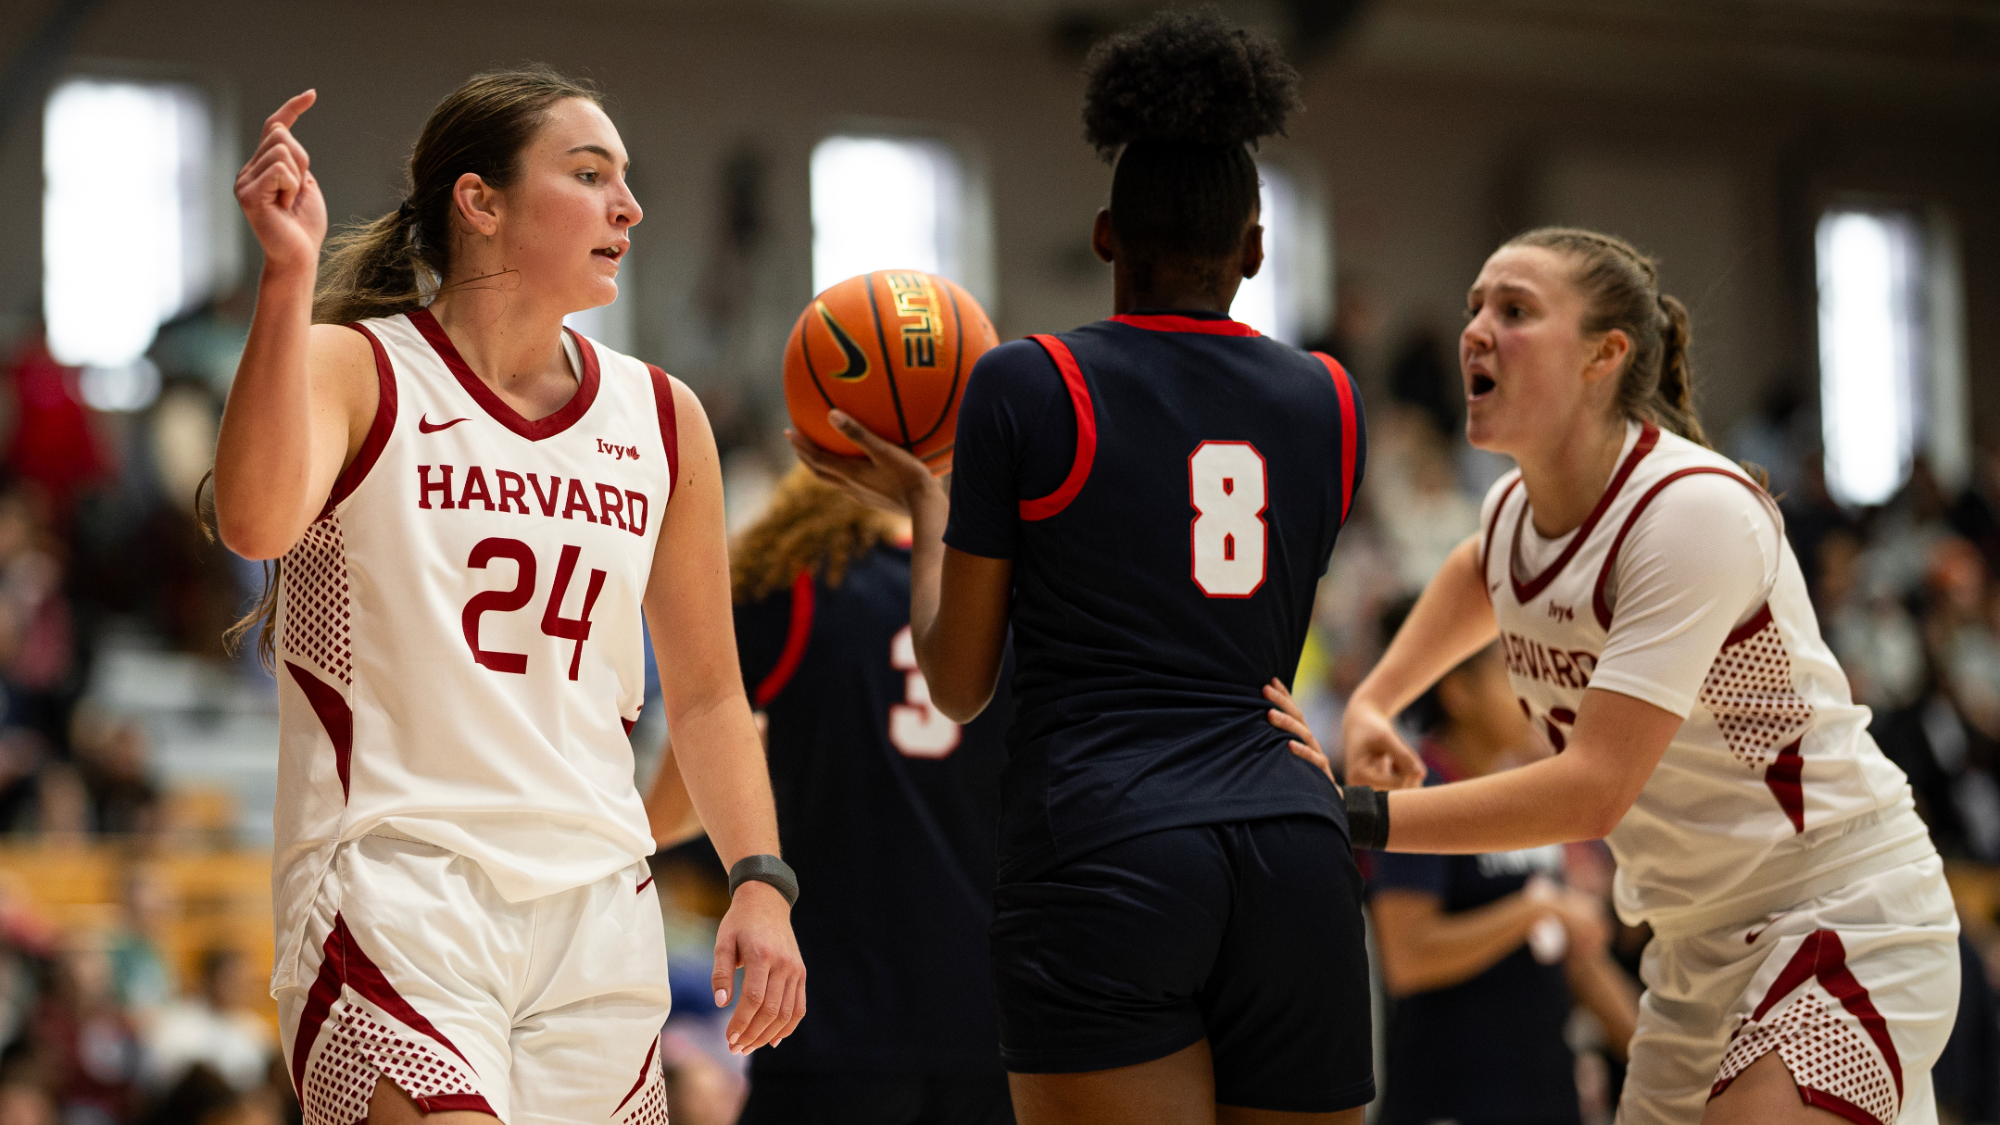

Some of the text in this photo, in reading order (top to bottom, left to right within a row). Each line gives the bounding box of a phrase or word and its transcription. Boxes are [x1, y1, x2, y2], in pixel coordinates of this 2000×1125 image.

[887, 273, 936, 369] ELITE
[596, 438, 625, 460] Ivy
[417, 464, 648, 537] HARVARD
[1188, 440, 1268, 599] 8
[461, 536, 607, 682] 24
[1501, 630, 1599, 689] ARVARD
